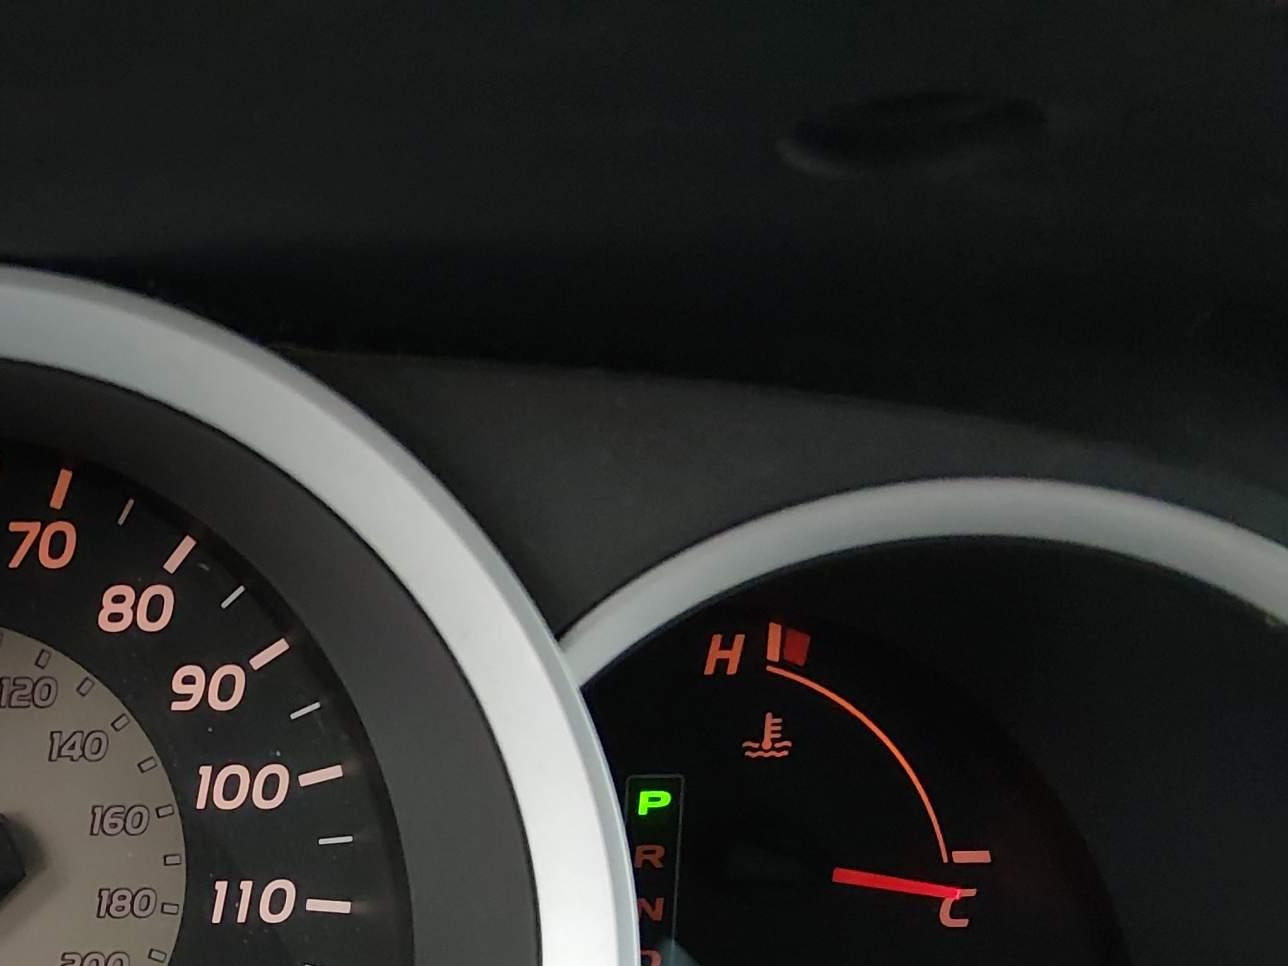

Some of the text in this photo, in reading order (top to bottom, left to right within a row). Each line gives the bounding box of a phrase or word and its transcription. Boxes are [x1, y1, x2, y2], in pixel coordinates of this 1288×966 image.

[8, 522, 76, 568] 70
[98, 585, 174, 633] 80
[703, 633, 746, 675] H
[170, 665, 246, 711] 90
[48, 730, 109, 762] 140
[195, 764, 289, 810] 100
[638, 791, 671, 815] P
[90, 804, 150, 836] 160
[634, 844, 665, 868] R
[96, 888, 157, 919] 180
[211, 880, 296, 924] 110
[638, 897, 665, 921] N
[939, 888, 977, 928] C
